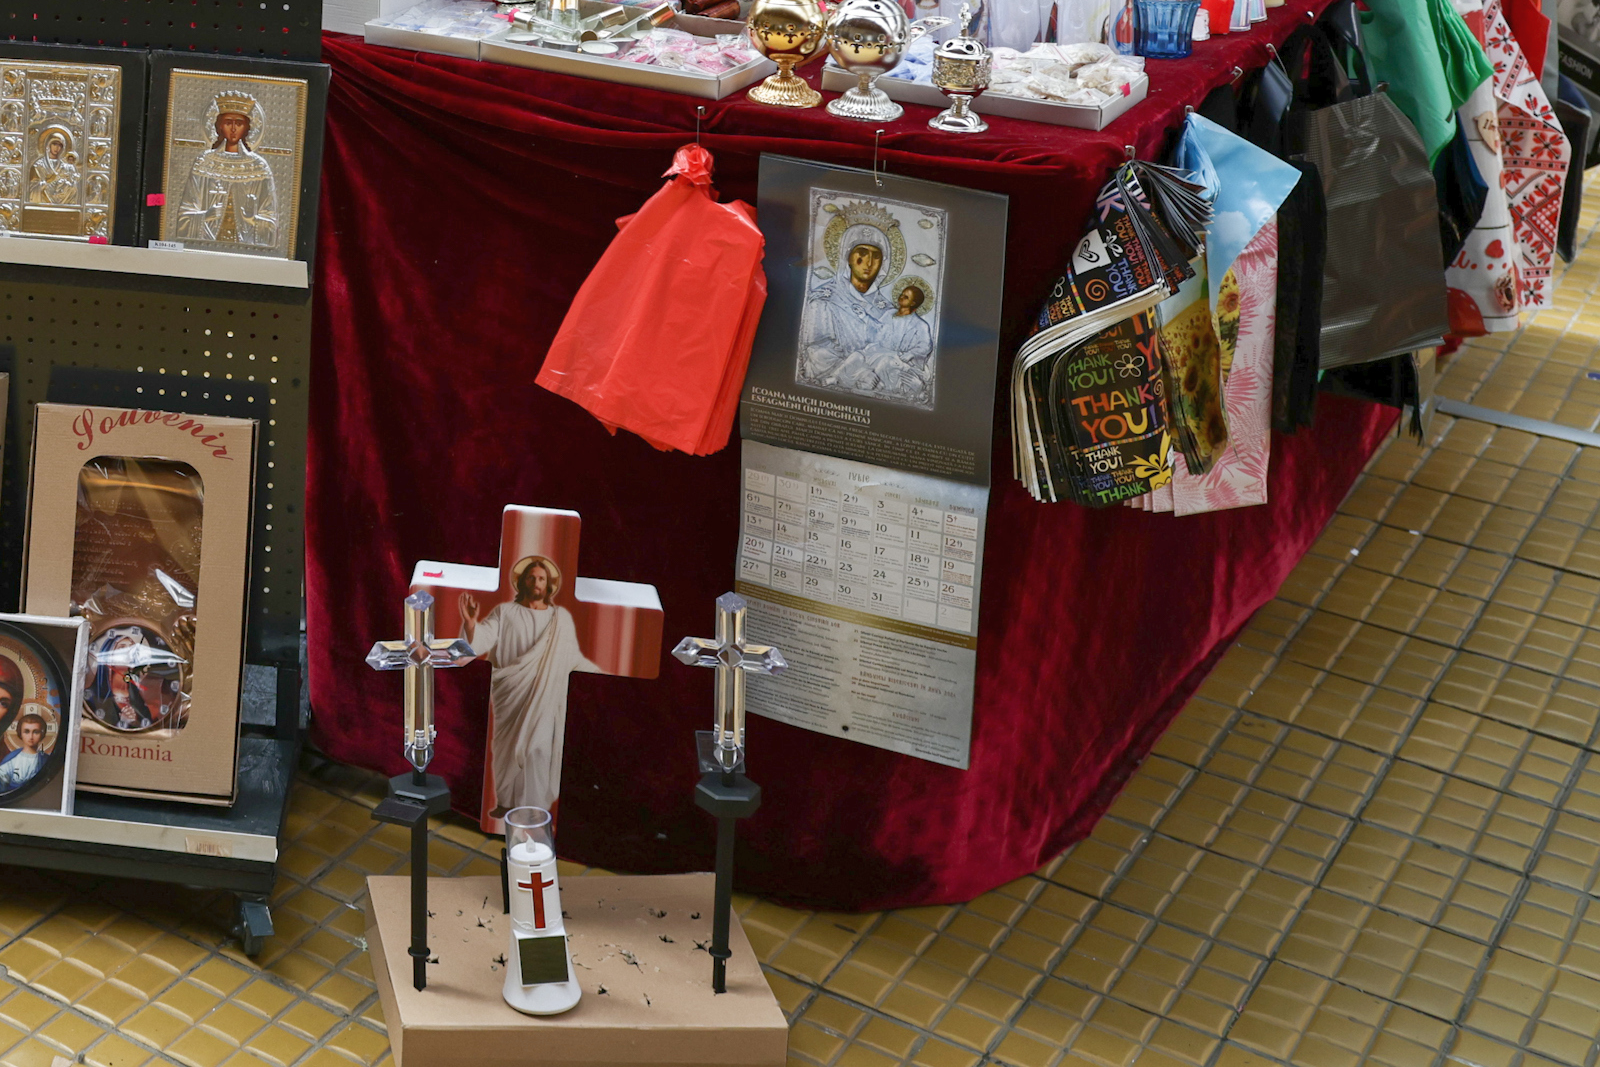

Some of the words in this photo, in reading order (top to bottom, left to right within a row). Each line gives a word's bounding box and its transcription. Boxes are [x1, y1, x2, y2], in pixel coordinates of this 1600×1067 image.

[1106, 263, 1128, 298] YOU!
[1118, 258, 1138, 294] THANK
[1067, 353, 1112, 377] THANK
[1068, 367, 1116, 392] YOU!
[751, 386, 787, 400] ICOANA
[787, 393, 818, 407] MAICII
[818, 400, 871, 417] DOMNULUI
[751, 394, 801, 411] ESFAGMENI
[1071, 383, 1155, 417] THANK
[72, 408, 235, 462] Souvenir
[1081, 403, 1159, 444] YOU!
[1085, 445, 1122, 462] THANK
[1089, 456, 1124, 475] YOU!
[1097, 481, 1148, 504] THANK
[1114, 474, 1136, 486] YOU!
[746, 493, 753, 501] 6
[778, 501, 784, 510] 7
[809, 509, 816, 518] 8
[841, 516, 848, 526] 9
[876, 523, 888, 533] 10
[910, 530, 920, 539] 11
[945, 537, 957, 547] 12
[810, 485, 814, 494] 1
[843, 494, 851, 503] 2
[877, 500, 885, 509] 3
[911, 507, 919, 516] 4
[946, 514, 953, 523] 5
[746, 515, 757, 524] 13
[777, 523, 787, 533] 14
[808, 531, 819, 541] 15
[840, 539, 852, 549] 16
[874, 546, 885, 555] 17
[910, 553, 922, 563] 18
[943, 560, 955, 570] 19
[743, 560, 755, 569] 27
[774, 568, 787, 578] 28
[805, 576, 818, 586] 29
[838, 584, 851, 594] 30
[871, 592, 883, 601] 31
[745, 536, 758, 546] 20
[775, 545, 786, 555] 21
[806, 554, 819, 564] 22
[839, 562, 853, 572] 23
[873, 569, 886, 579] 24
[907, 576, 921, 586] 25
[942, 583, 955, 593] 26
[80, 735, 173, 764] Romania
[12, 767, 21, 781] 5
